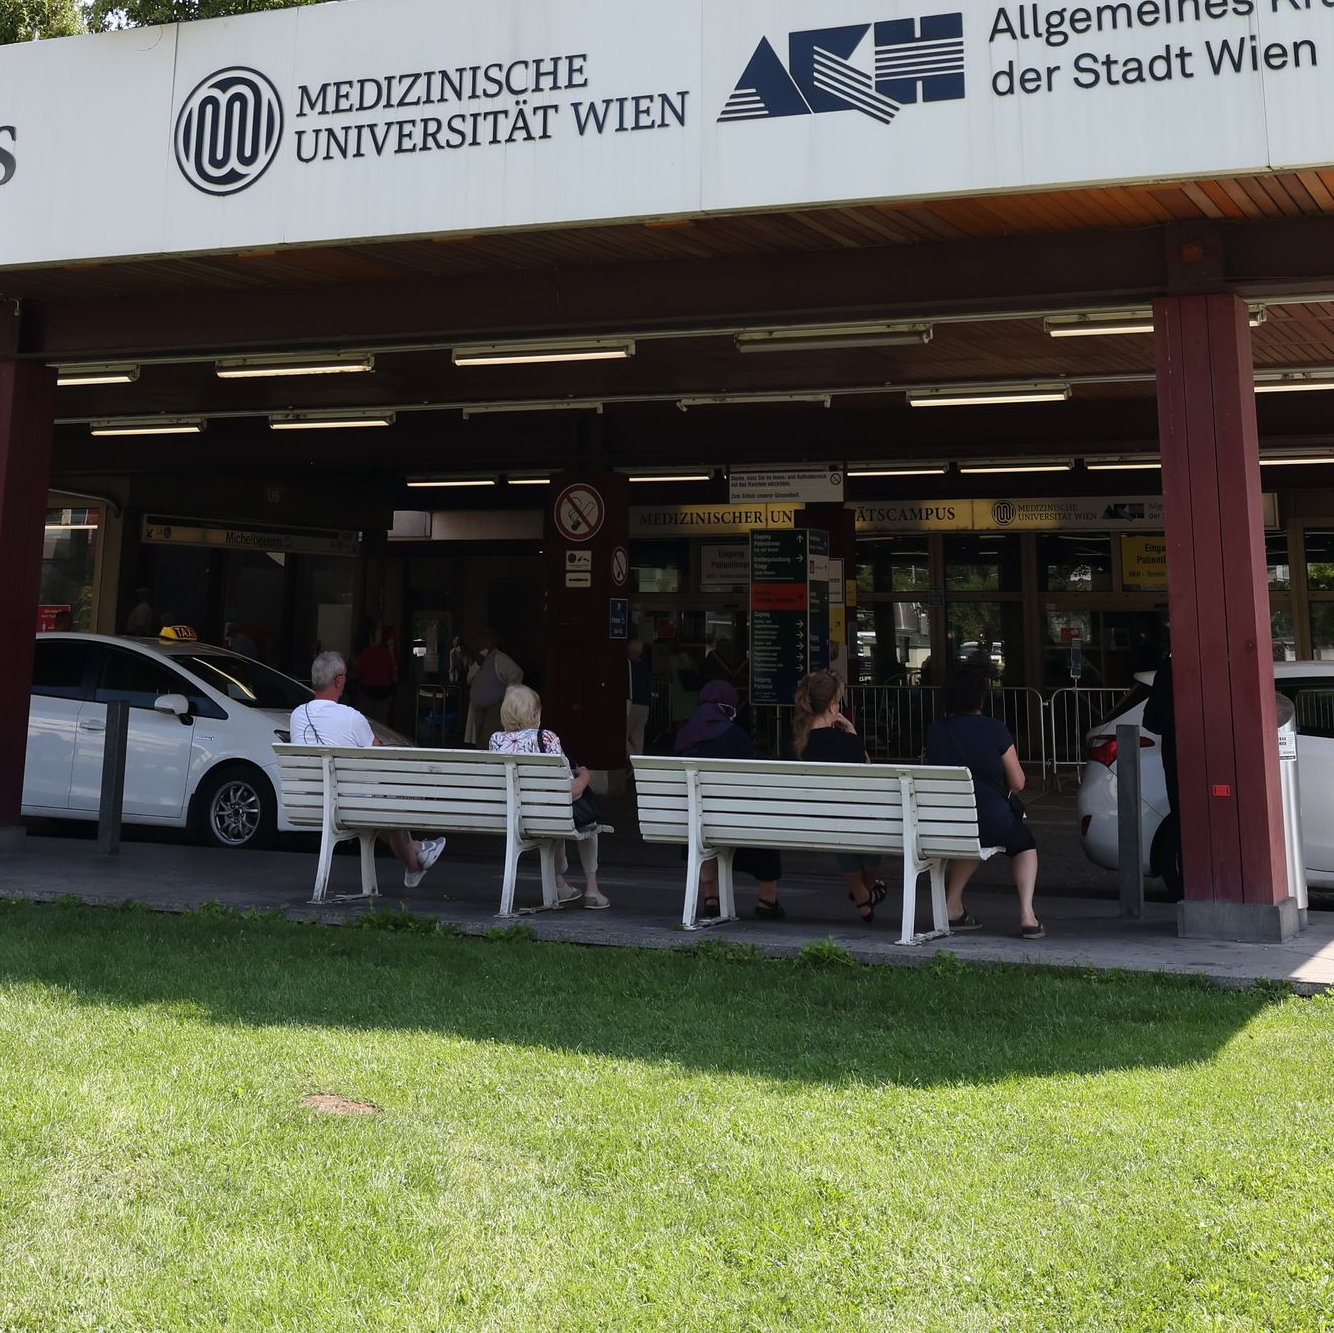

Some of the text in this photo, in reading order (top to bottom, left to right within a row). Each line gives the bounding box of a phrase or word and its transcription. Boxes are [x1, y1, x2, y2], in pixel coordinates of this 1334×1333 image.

[295, 52, 589, 118] MEDIZINISCHE
[991, 34, 1318, 97] der Stadt Wien
[294, 90, 690, 164] UNIVERSITÄT WIEN
[639, 510, 764, 526] MEDIZINISCHER
[1018, 503, 1078, 513] MEDIZINISCHE
[1073, 511, 1097, 520] WIEN
